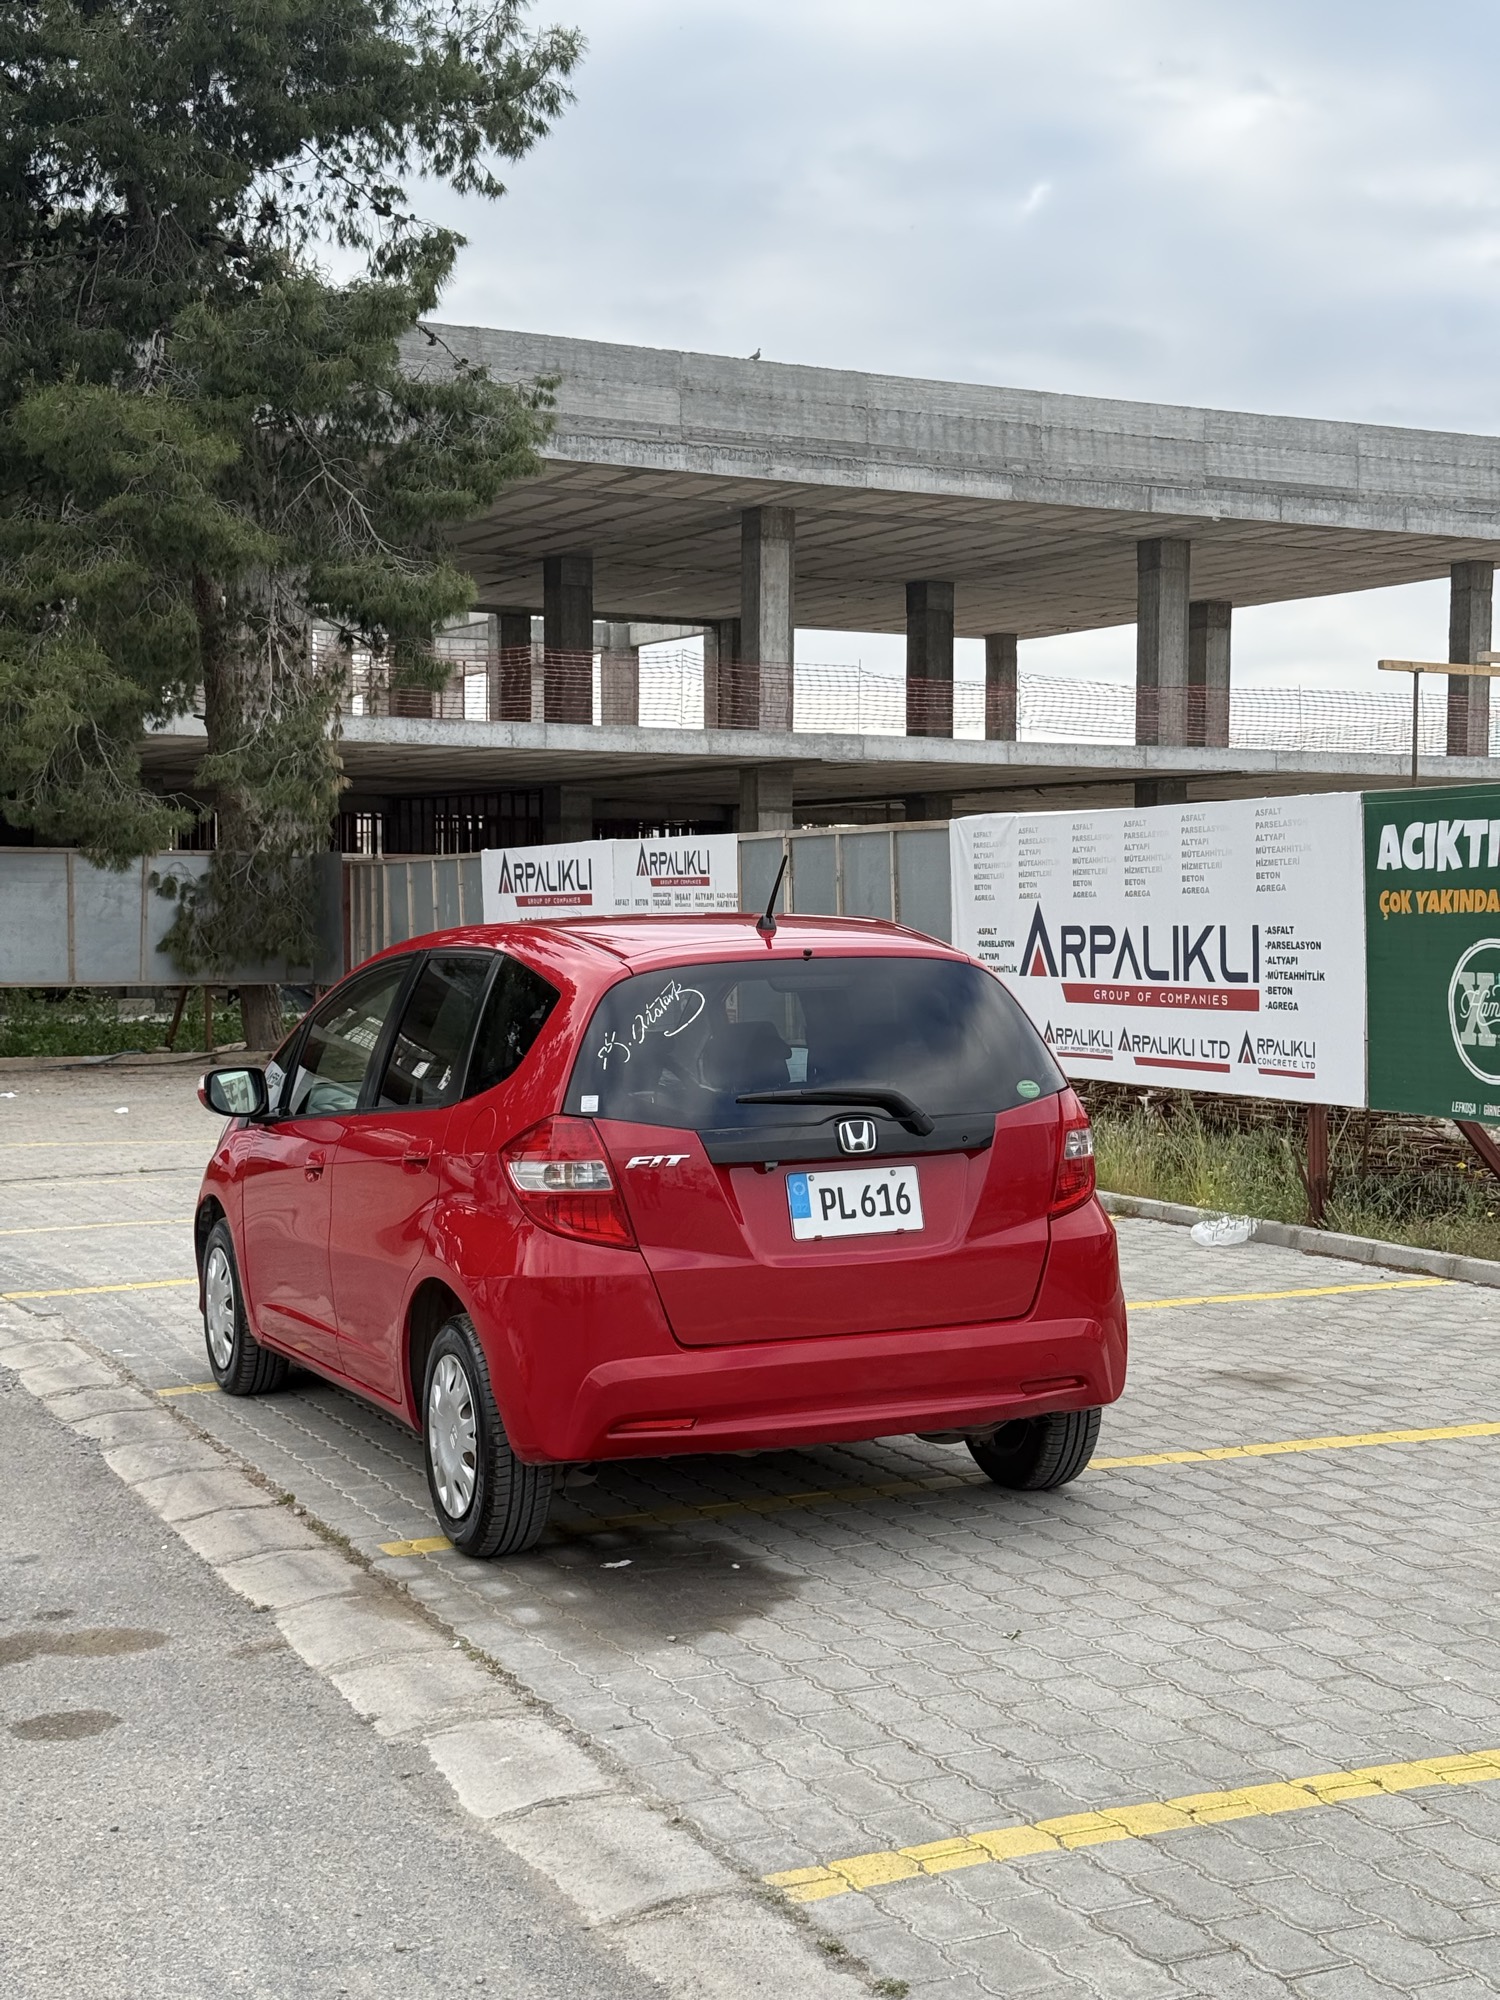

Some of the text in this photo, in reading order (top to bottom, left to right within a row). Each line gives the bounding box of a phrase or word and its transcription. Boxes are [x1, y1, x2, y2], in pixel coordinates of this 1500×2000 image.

[1255, 807, 1282, 817] ASFALT
[1181, 813, 1206, 822] ASFALT
[1072, 823, 1094, 831] ASFALT
[1123, 819, 1147, 828] ASFALT
[1018, 827, 1039, 835] ASFALT
[1181, 837, 1209, 846] ALTYAPI
[1255, 832, 1286, 842] ALTYAPI
[1072, 846, 1097, 854] ALTYAPI
[1123, 843, 1150, 851] ALTYAPI
[1376, 819, 1500, 872] ACIKTI
[636, 842, 710, 877] ARPALIKLI
[1255, 857, 1301, 867] HİZMETLERİ
[1124, 865, 1163, 874] HİZMETLERİ
[1181, 861, 1223, 870] HİZMETLERİ
[498, 851, 593, 895] ARPALIKLI
[1255, 871, 1281, 880] BETON
[1124, 878, 1146, 886] BETON
[1181, 874, 1205, 883] BETON
[1181, 886, 1210, 895] AGREGA
[1255, 883, 1287, 893] AGREGA
[1124, 890, 1151, 898] AGREGA
[527, 897, 543, 905] GROUP
[553, 896, 581, 904] COMPANIES
[1379, 888, 1500, 920] ÇOK YAKINDA
[1264, 925, 1295, 935] -ASFALT
[1018, 901, 1260, 983] ARPALIKLI
[1264, 941, 1322, 951] -PARSELASYON
[1264, 956, 1299, 966] -ALTYAPI
[1264, 969, 1326, 982] -MÜTEAHHİTLİK
[1264, 986, 1293, 996] -BETON
[1093, 989, 1229, 1006] GROUP OF COMPANIES
[1264, 1001, 1299, 1012] -AGREGA
[1043, 1019, 1113, 1048] ARPALIKLI
[1117, 1026, 1231, 1060] ARPALIKLI LTD
[1237, 1029, 1316, 1064] ARPALIKLI
[1257, 1057, 1316, 1070] CONCRETE LTD
[625, 1154, 691, 1169] FIT
